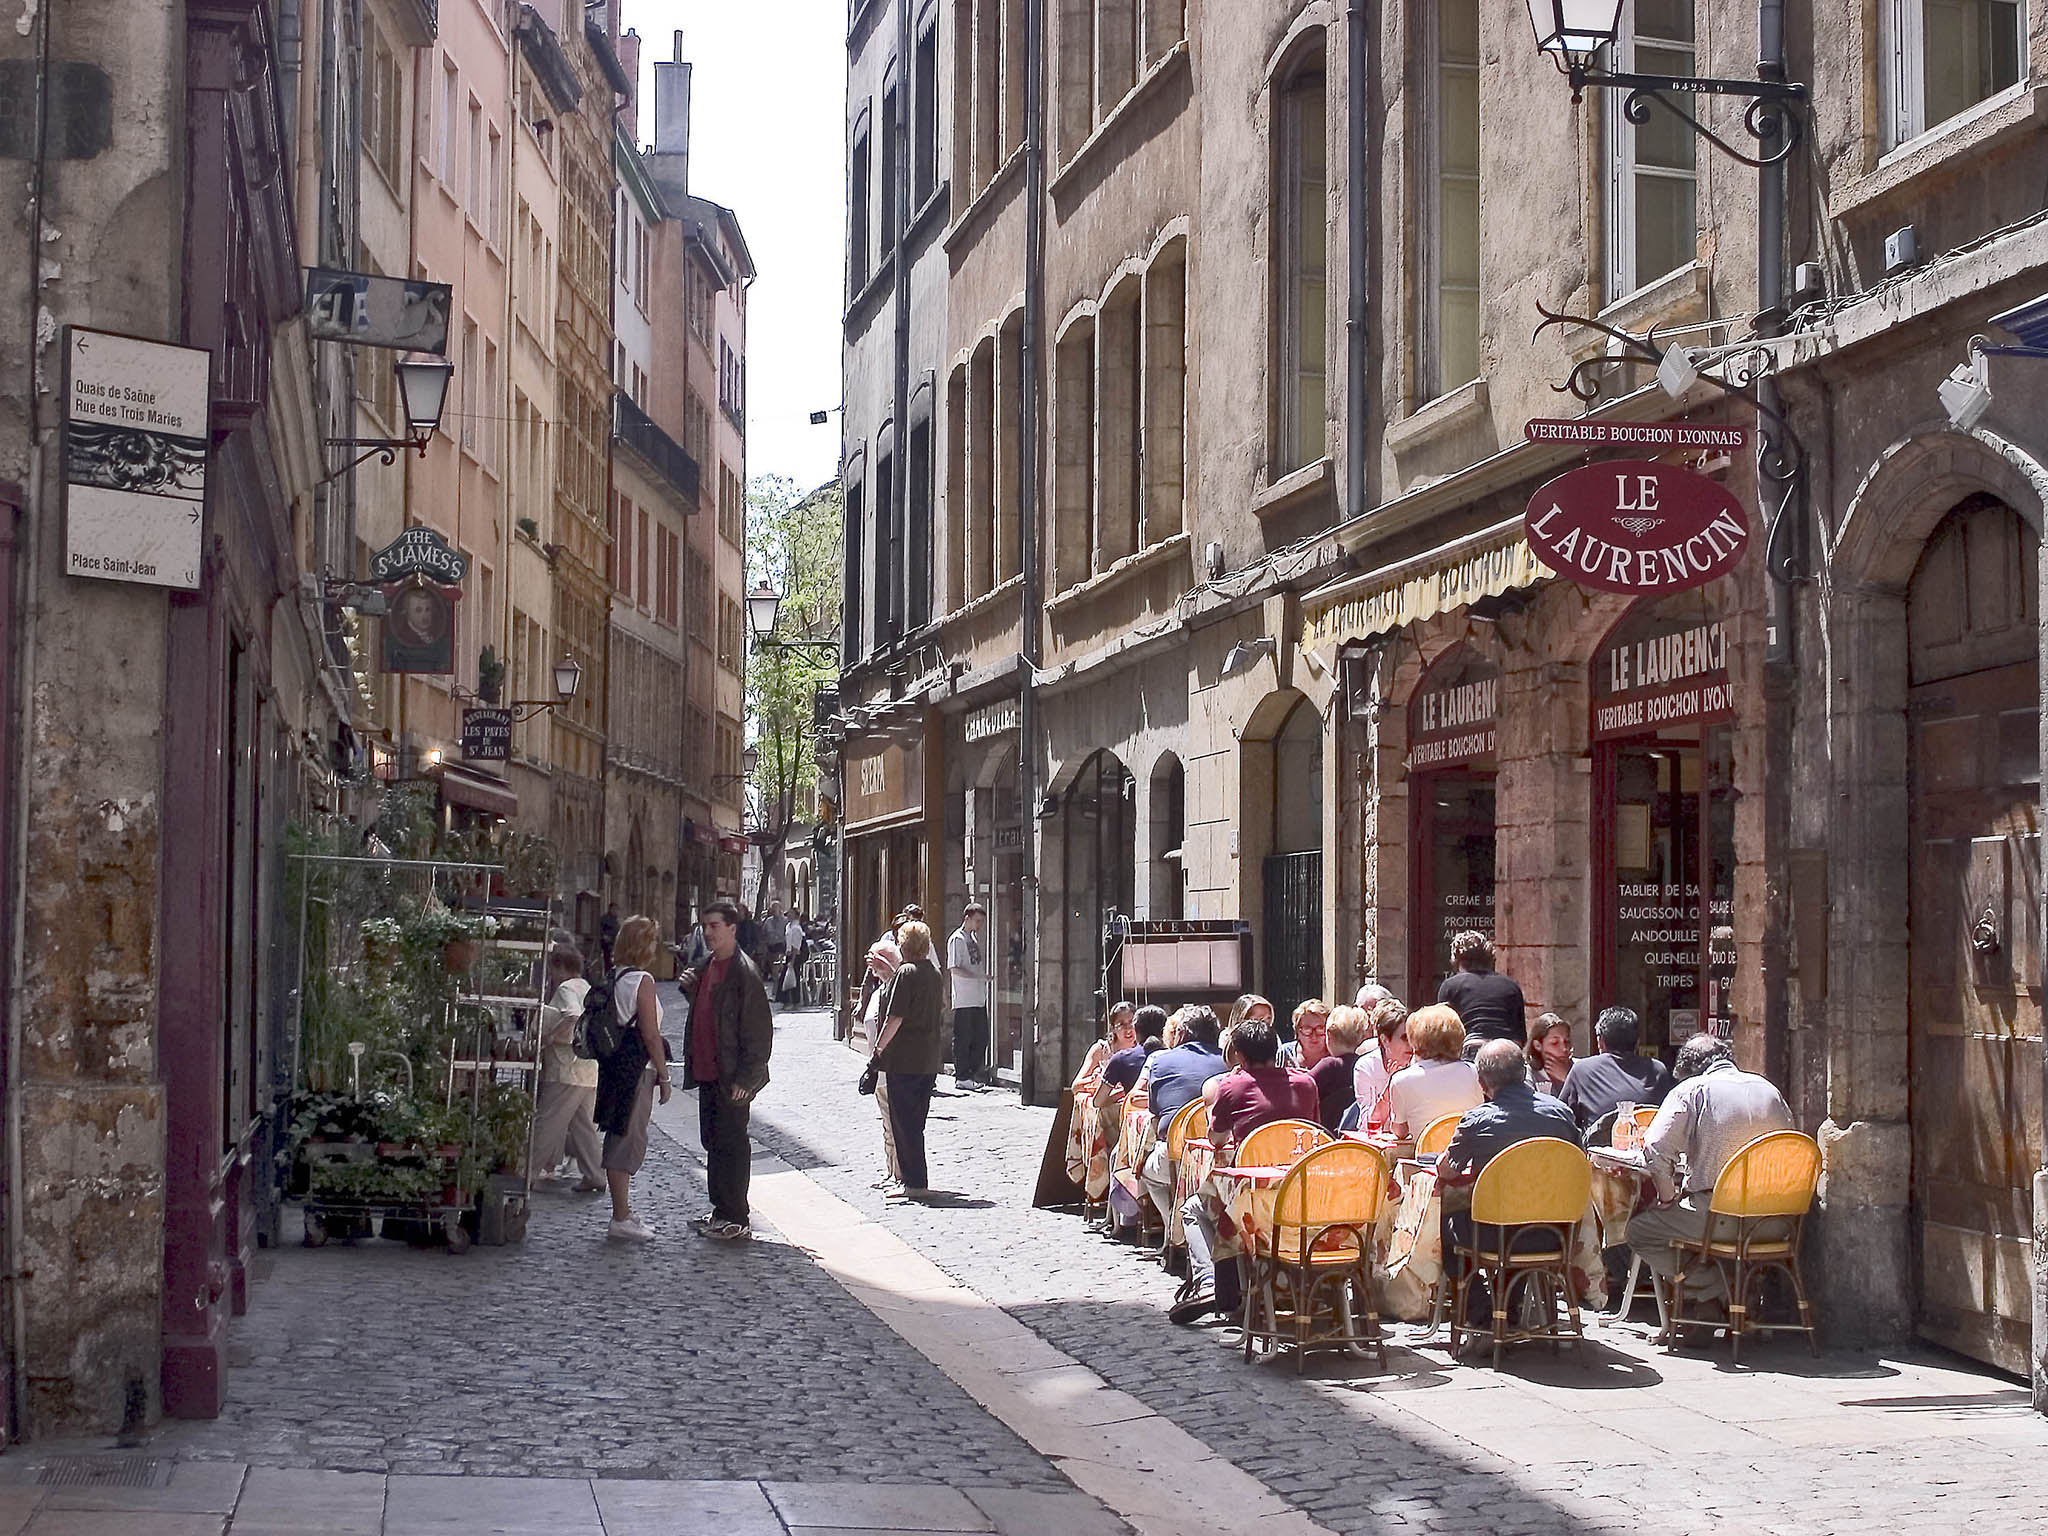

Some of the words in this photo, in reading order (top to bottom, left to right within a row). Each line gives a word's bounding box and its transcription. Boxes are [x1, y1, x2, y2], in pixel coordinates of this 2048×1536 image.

[76, 379, 106, 397] Quais
[108, 385, 121, 399] de
[123, 387, 156, 405] Saône
[75, 398, 96, 414] Rue
[99, 402, 117, 417] des
[120, 405, 145, 422] Trois
[147, 409, 182, 428] Maries
[1529, 423, 1606, 440] VERITABLE
[1610, 427, 1673, 443] BOUCHON
[1677, 429, 1743, 445] LYONNAIS
[1615, 474, 1660, 511] LE
[405, 530, 433, 545] THE
[1530, 502, 1747, 587] LAURENCIN
[72, 553, 100, 569] Place
[103, 557, 156, 577] Saint-Jean
[1611, 645, 1629, 692] LE
[1422, 693, 1436, 731] LE
[1597, 700, 1643, 731] VERITABLE
[1647, 689, 1699, 722] BOUCHON
[464, 726, 481, 737] LES
[481, 746, 504, 757] JEAN
[1412, 740, 1446, 765] VERITABLE
[1447, 732, 1485, 758] BOUCHON
[1445, 895, 1480, 906] CREME
[1619, 884, 1659, 897] TABLIER
[1665, 884, 1680, 897] DE
[1619, 907, 1683, 919] SAUCISSON
[1152, 921, 1211, 933] MENU
[1712, 951, 1726, 965] DUO
[1656, 974, 1694, 988] TRIPES
